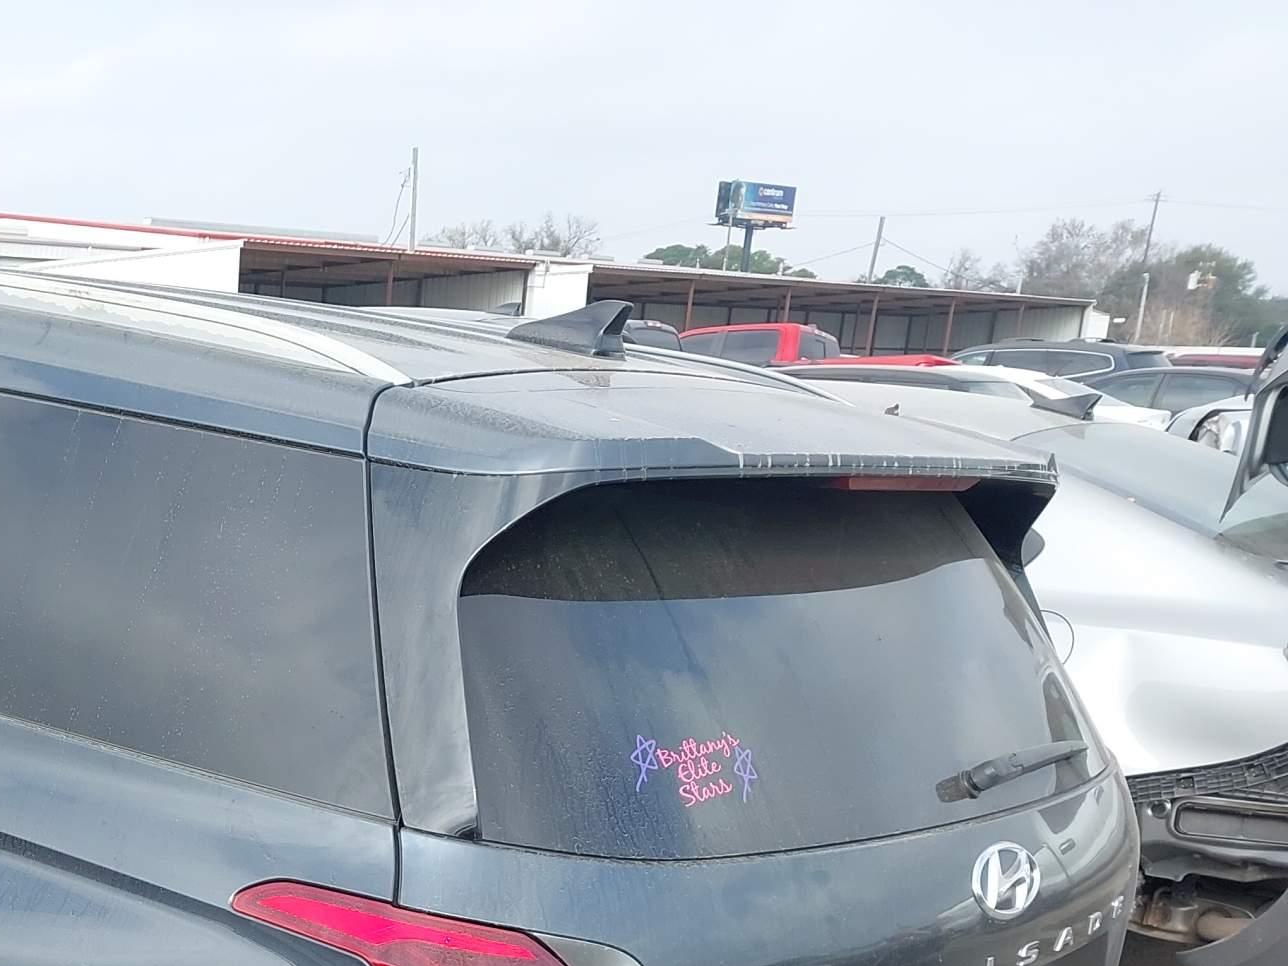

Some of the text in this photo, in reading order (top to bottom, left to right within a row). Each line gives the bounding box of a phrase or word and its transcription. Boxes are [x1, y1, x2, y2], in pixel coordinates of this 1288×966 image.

[656, 731, 739, 768] Brittany's
[678, 757, 721, 782] Elite
[679, 778, 732, 807] Stars
